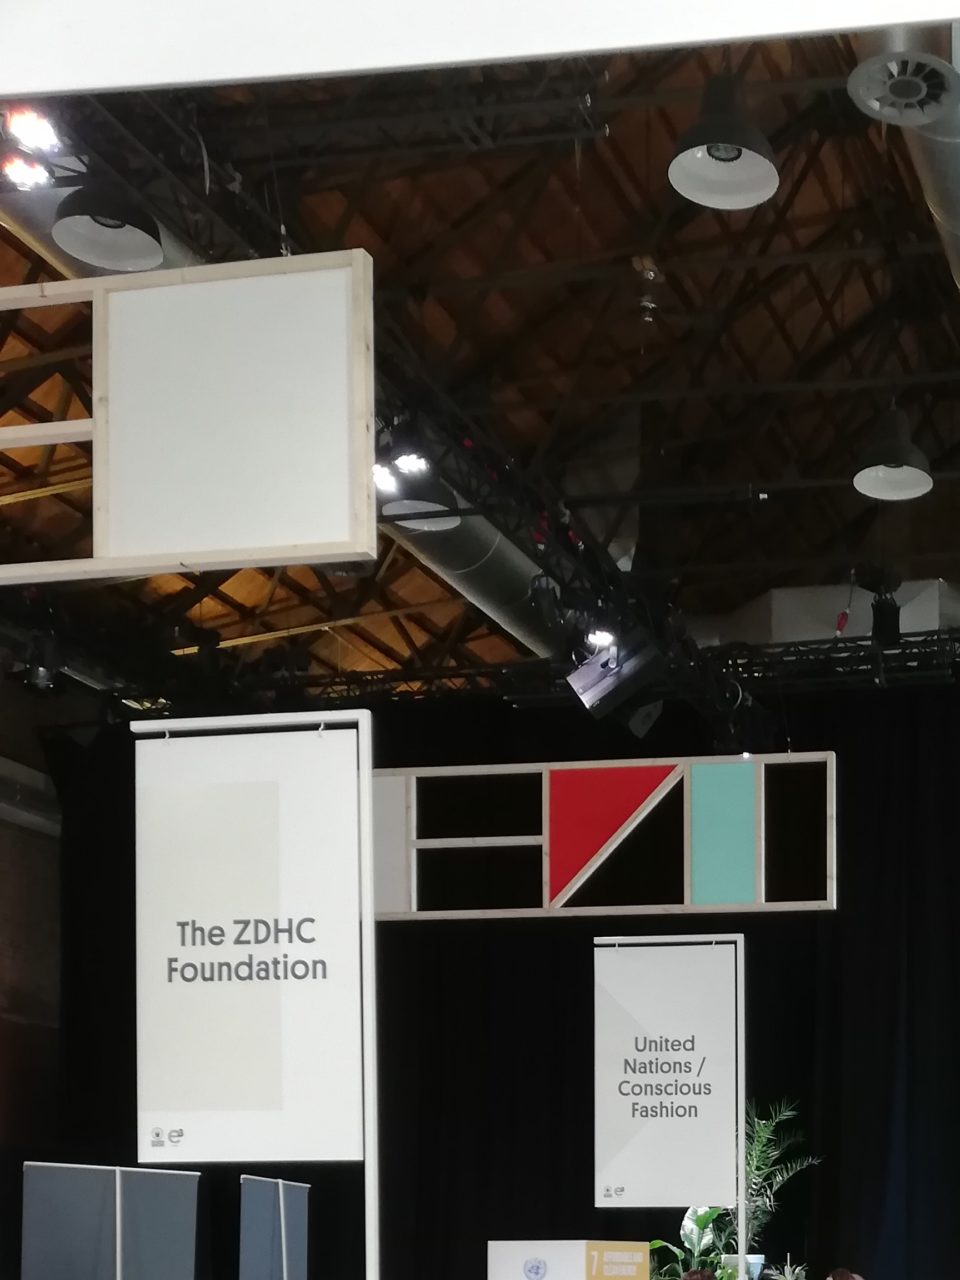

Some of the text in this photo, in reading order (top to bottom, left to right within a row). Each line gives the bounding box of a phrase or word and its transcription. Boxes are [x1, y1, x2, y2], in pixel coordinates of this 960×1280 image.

[176, 917, 316, 946] The ZDHC
[167, 954, 327, 983] Foundation
[634, 1035, 695, 1052] United
[624, 1058, 692, 1074] Nations
[618, 1080, 712, 1096] Conscious
[632, 1102, 698, 1118] Fashion
[591, 1251, 598, 1276] 7
